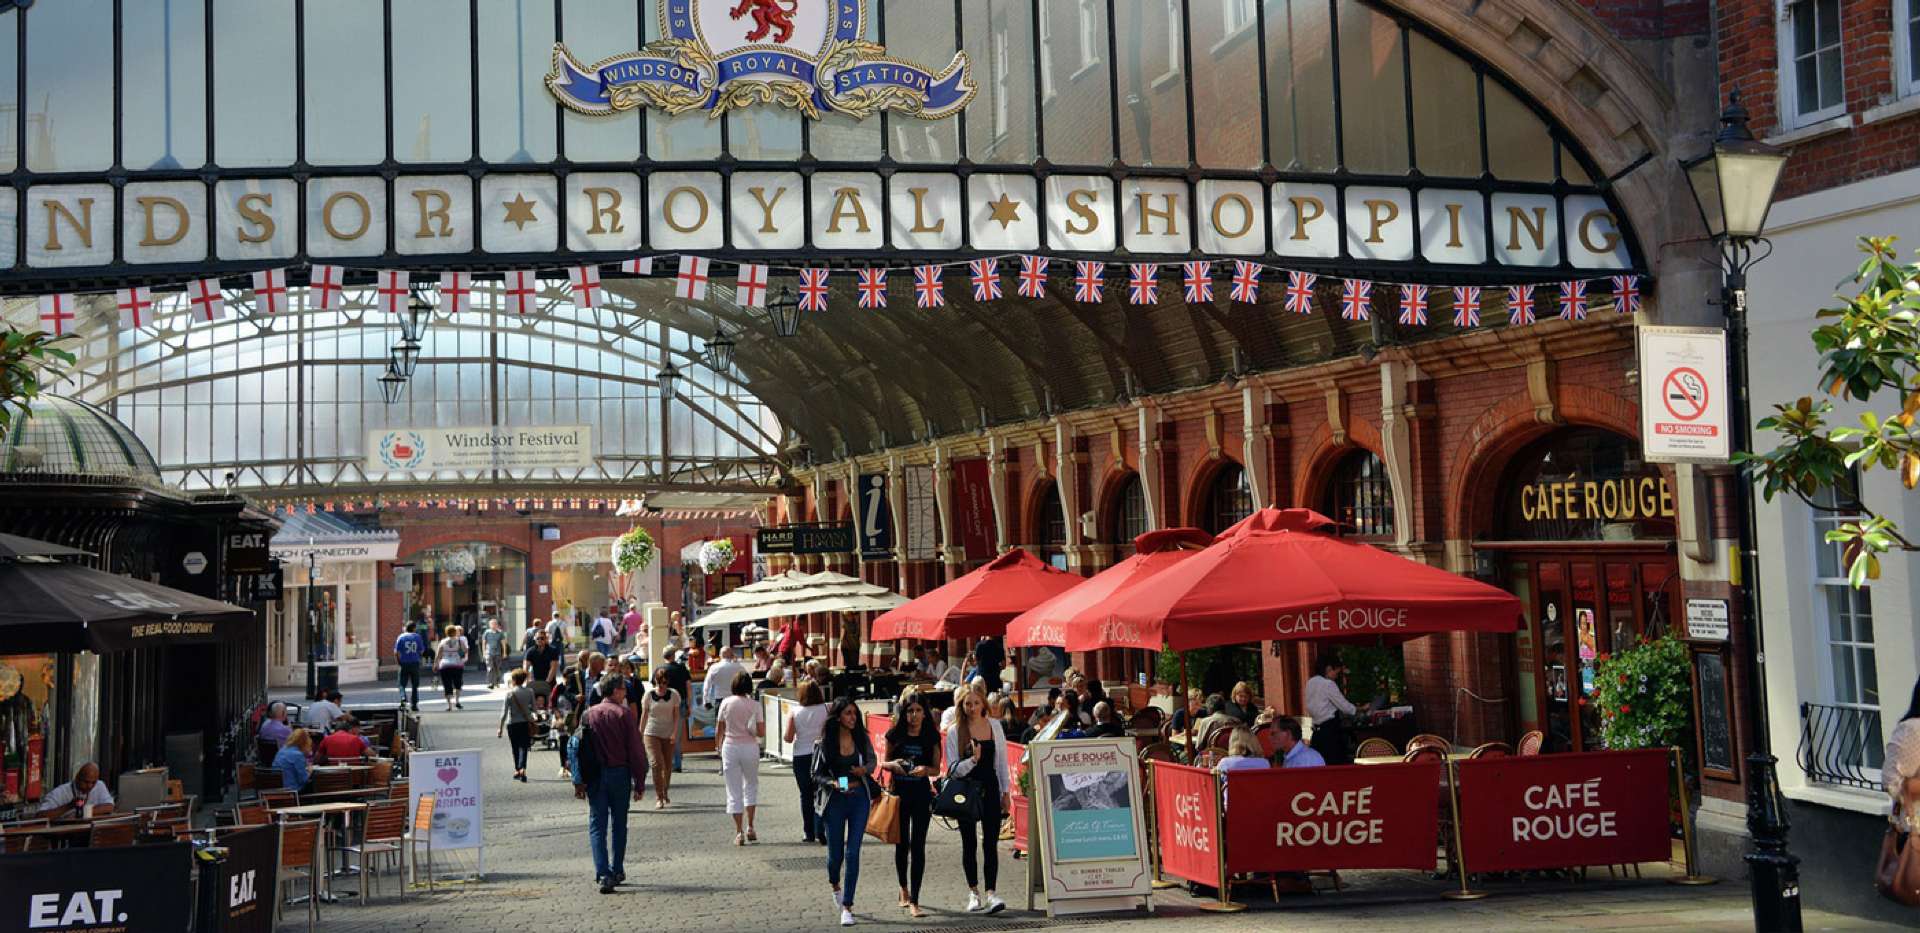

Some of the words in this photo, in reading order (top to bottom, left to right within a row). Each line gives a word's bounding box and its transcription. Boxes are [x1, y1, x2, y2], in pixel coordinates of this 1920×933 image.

[603, 63, 694, 84] WINDSOR
[732, 57, 799, 74] ROYAL
[840, 67, 928, 90] STATION
[42, 187, 454, 251] NDSOR
[583, 186, 945, 235] ROYAL
[1065, 188, 1620, 254] SHOPPING
[445, 433, 514, 448] Windsor
[519, 431, 579, 446] Festival
[1661, 424, 1673, 433] NO
[1674, 425, 1713, 435] SMOKING
[1521, 472, 1579, 521] CAFÉ
[1584, 476, 1675, 519] ROUGE
[231, 534, 265, 549] EAT.
[301, 547, 369, 557] CONNECTION
[131, 624, 145, 638] THE
[146, 622, 162, 636] REAL
[163, 622, 181, 635] FOOD
[182, 622, 215, 634] COMPANY
[1275, 606, 1331, 634] CAFÉ
[1338, 607, 1409, 630] ROUGE
[434, 757, 462, 767] EAT.
[1054, 752, 1081, 763] CAFÉ
[1082, 750, 1117, 761] ROUGE
[1175, 791, 1202, 822] CAFÉ
[1290, 785, 1374, 817] CAFÉ
[1523, 776, 1602, 810] CAFÉ
[1175, 822, 1210, 853] ROUGE
[1276, 818, 1384, 848] ROUGE
[1512, 811, 1618, 842] ROUGE
[230, 869, 257, 908] EAT.
[28, 889, 128, 929] EAT.
